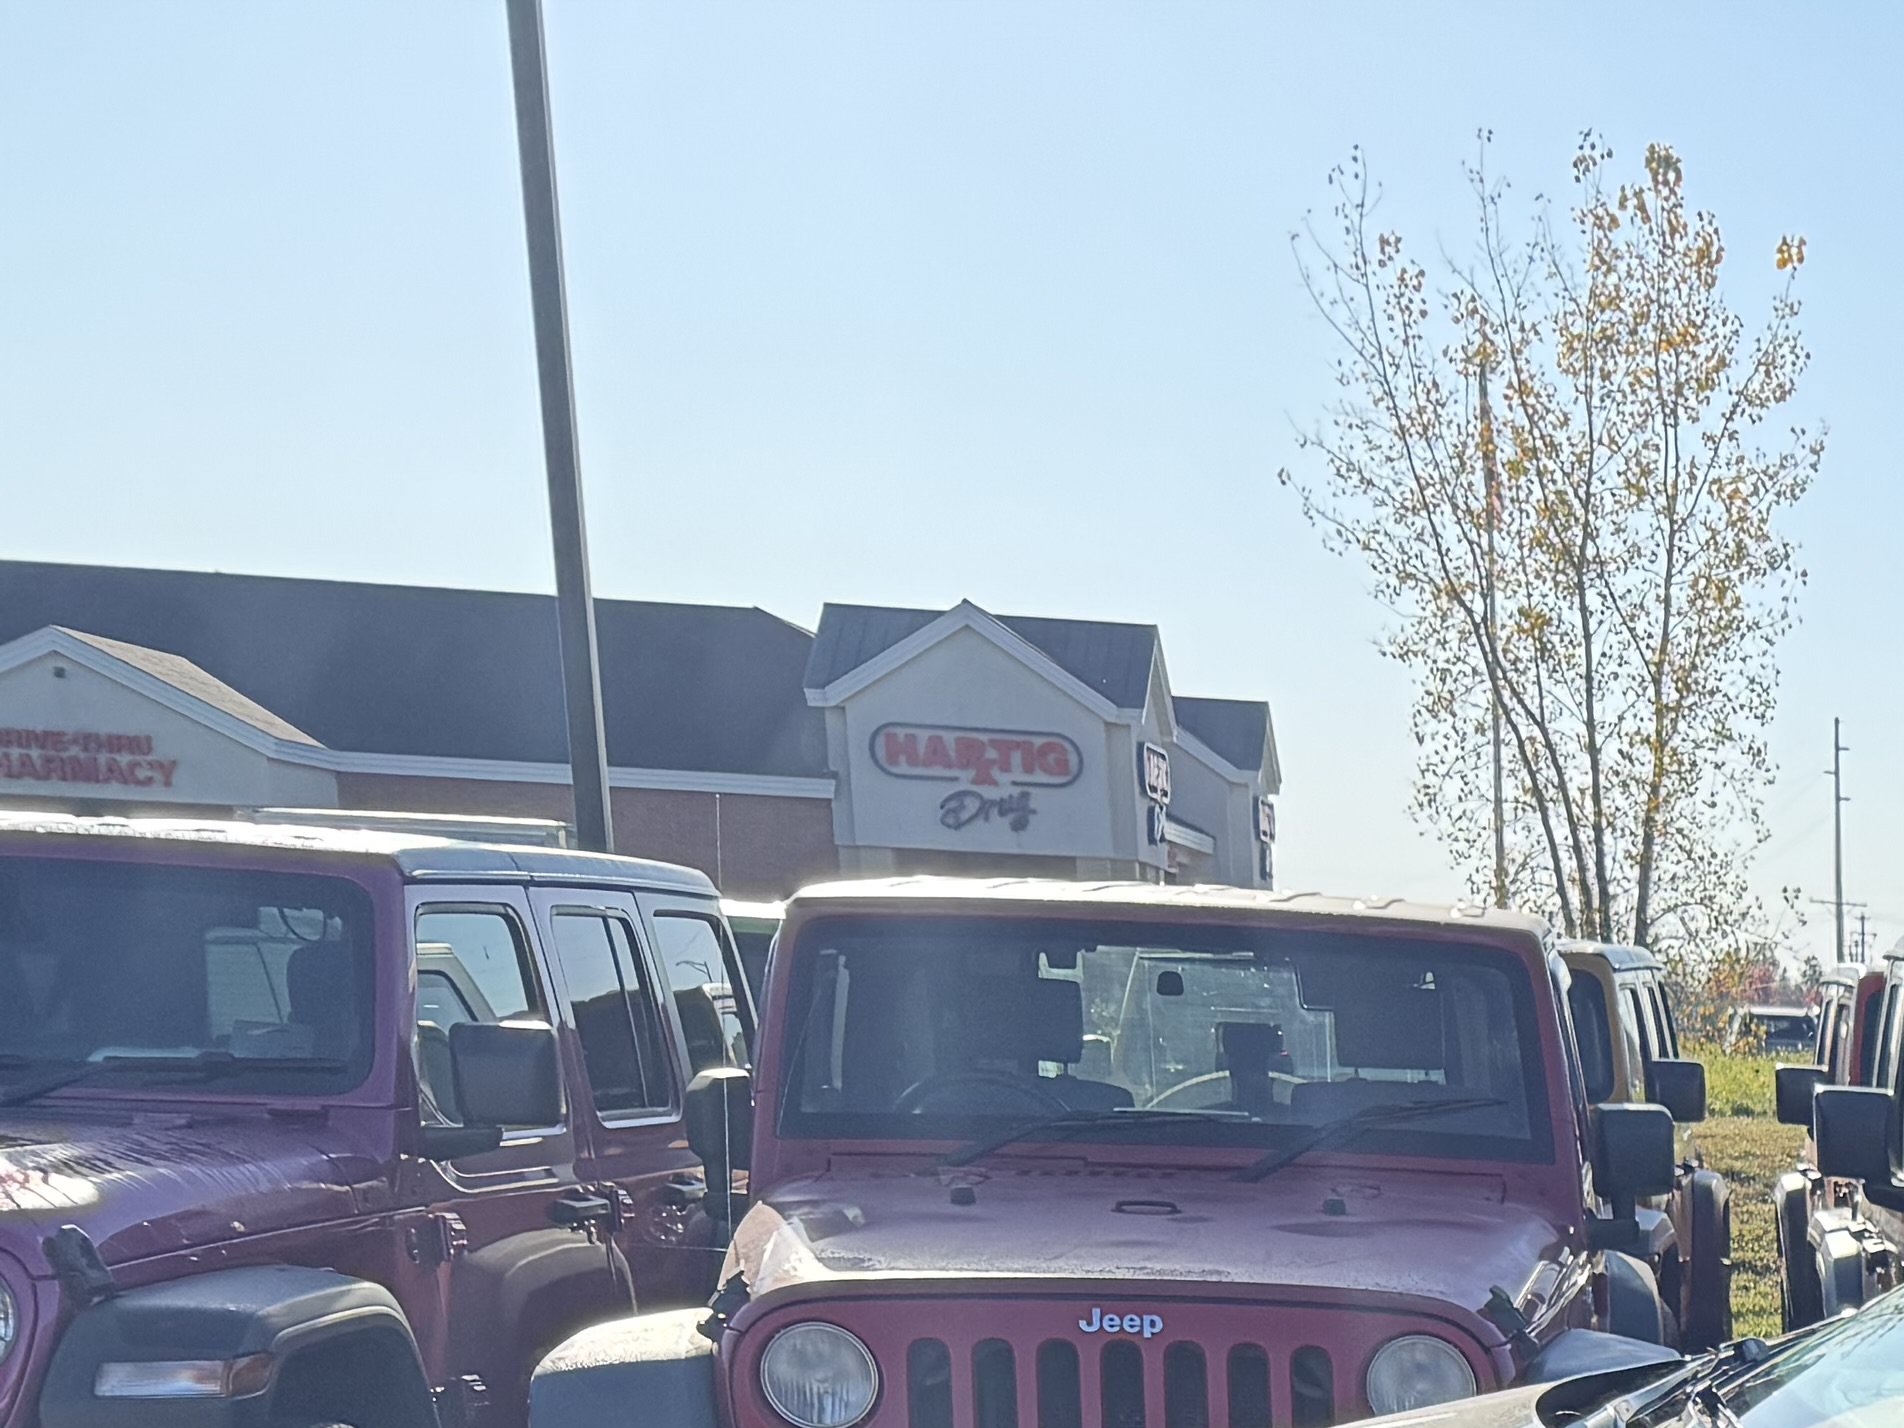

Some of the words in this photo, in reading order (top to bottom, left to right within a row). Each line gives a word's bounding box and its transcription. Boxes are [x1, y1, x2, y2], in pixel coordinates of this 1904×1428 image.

[0, 727, 154, 756] RIVE-THRU
[884, 731, 1071, 787] HARTIG
[939, 789, 1037, 832] Drug
[1078, 1307, 1164, 1338] Jeep
